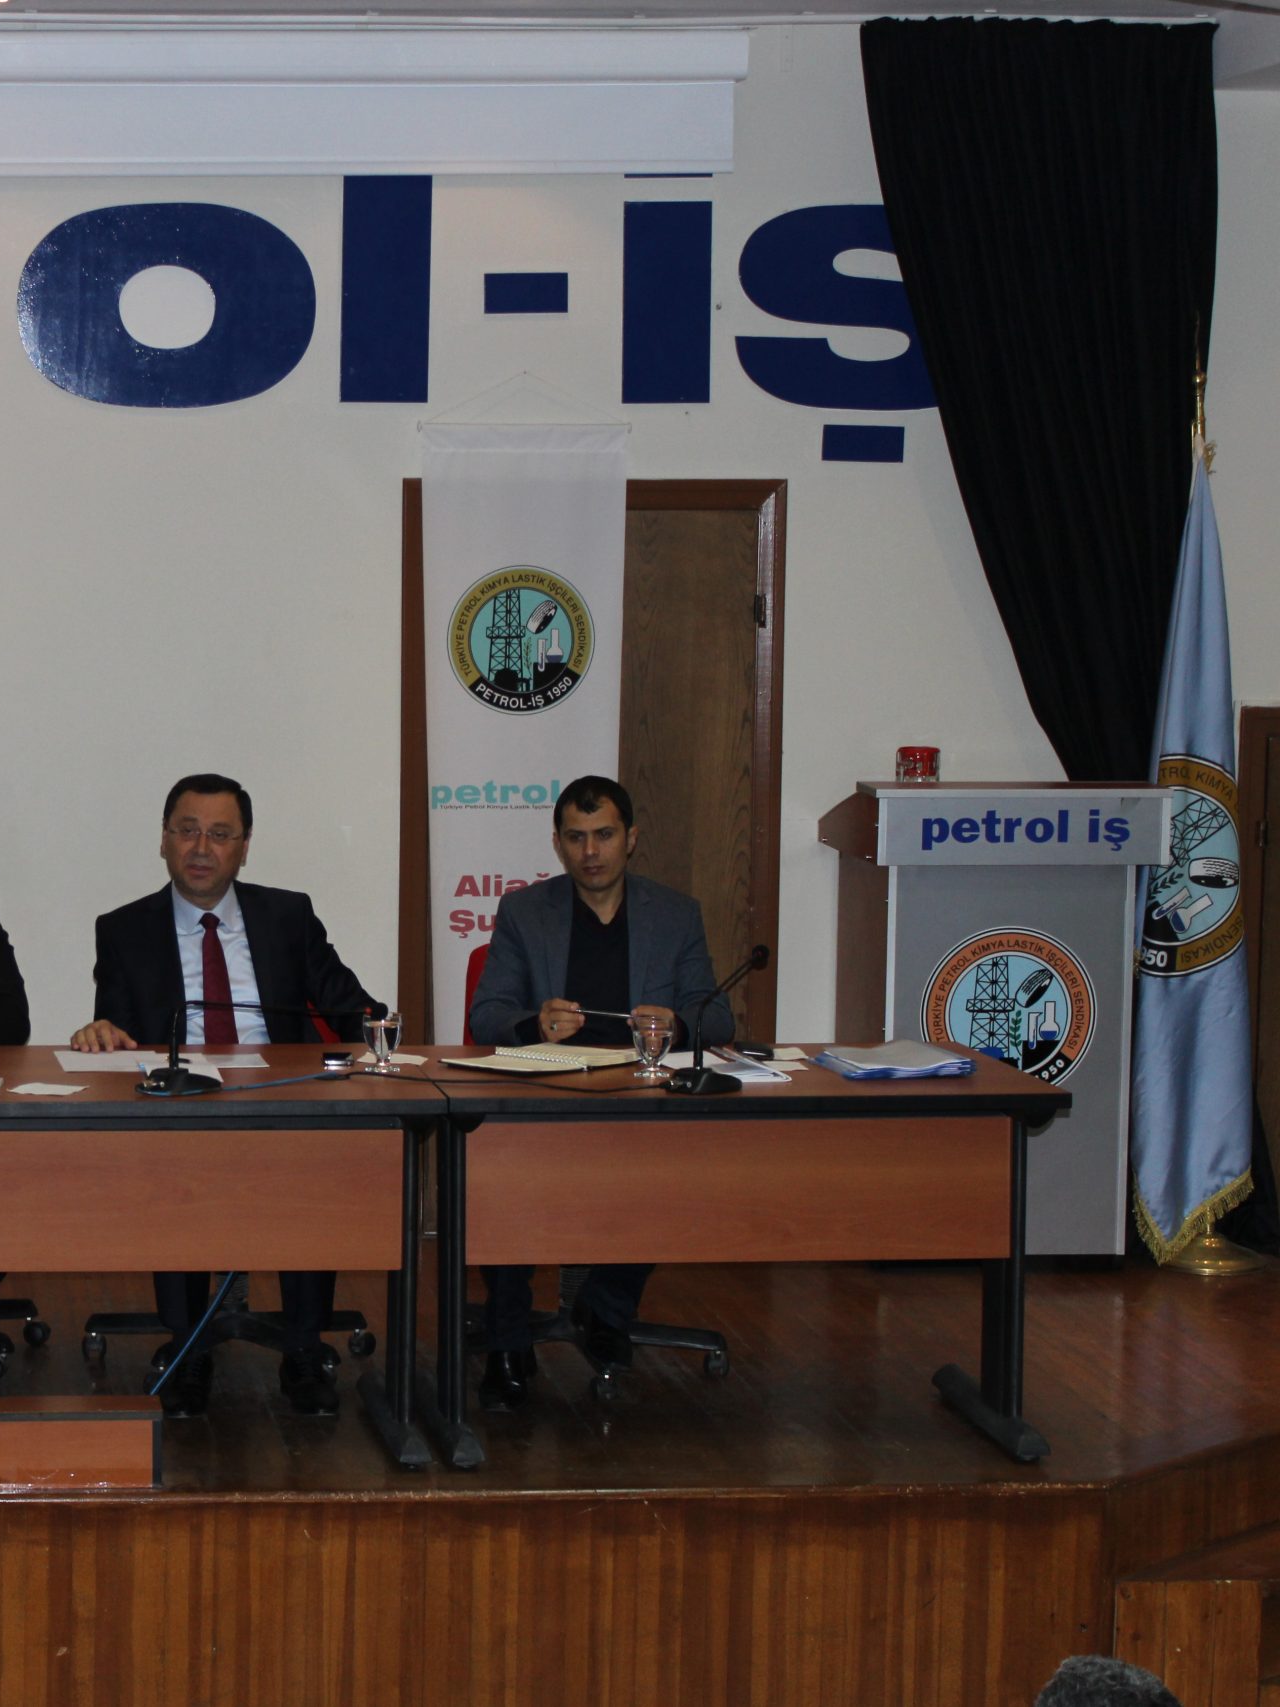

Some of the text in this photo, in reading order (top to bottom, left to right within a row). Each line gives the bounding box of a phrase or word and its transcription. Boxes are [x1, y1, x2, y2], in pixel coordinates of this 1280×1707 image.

[458, 597, 482, 632] PETROL
[480, 576, 510, 597] KİMYA
[511, 574, 547, 584] LASTİK
[475, 676, 573, 709] PETROL-İŞ 1950
[431, 779, 561, 810] petrol
[921, 809, 1131, 851] petrol iş
[931, 938, 1085, 1050] TÜRKİYE PETROL KİMYA LASTİK İŞÇİLERİ SENDİKASI
[1035, 1058, 1066, 1081] 950
